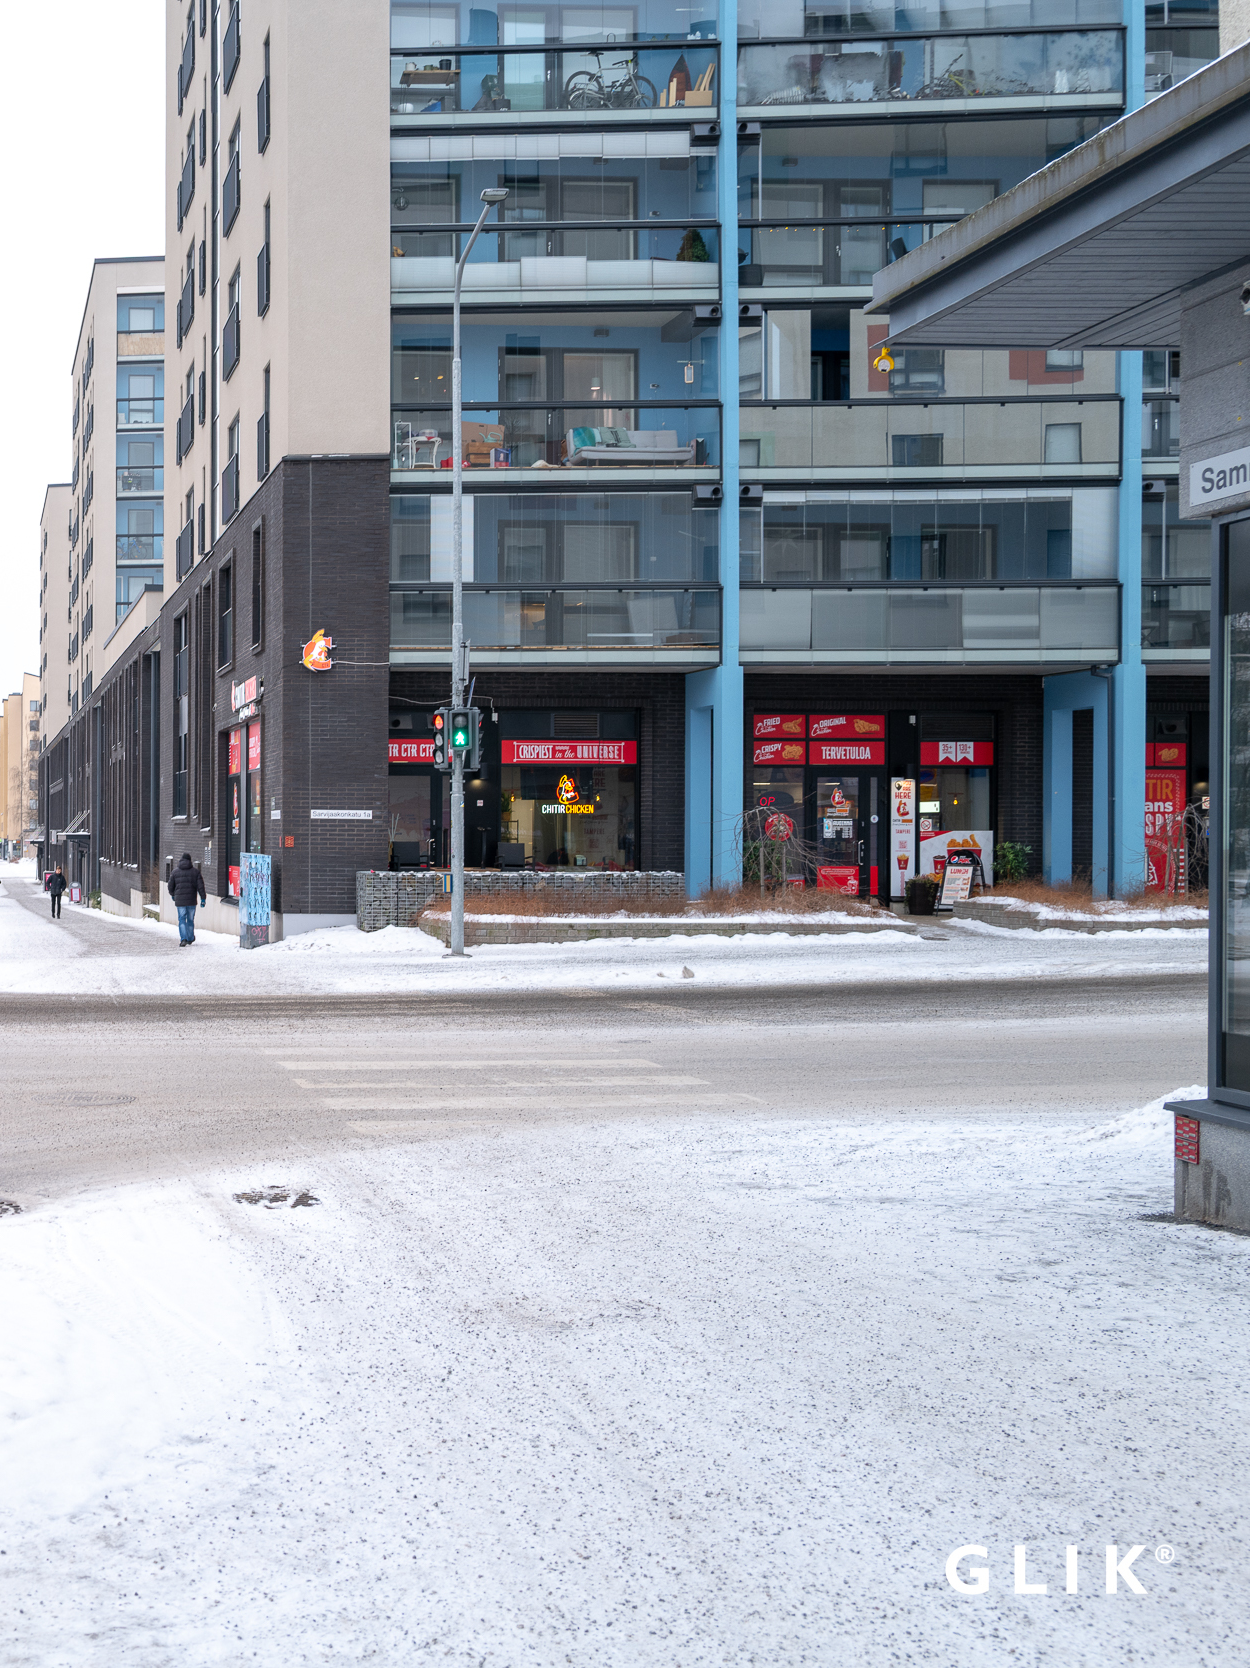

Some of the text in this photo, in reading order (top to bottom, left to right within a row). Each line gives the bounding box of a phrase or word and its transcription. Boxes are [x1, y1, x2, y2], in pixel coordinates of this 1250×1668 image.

[1201, 463, 1250, 494] Sam
[763, 717, 781, 727] FRIED
[819, 716, 846, 728] ORIGINAL
[388, 744, 399, 757] TR
[401, 744, 417, 757] CTR
[518, 745, 553, 759] CRISPIEST
[564, 749, 575, 758] the
[576, 746, 619, 759] UNIVERSE
[761, 743, 782, 753] CRISPY
[821, 747, 871, 759] TERVETULOA
[1146, 779, 1173, 799] TIR
[541, 804, 595, 814] CHITIR CHICKEN
[1145, 801, 1173, 812] ans
[1145, 813, 1173, 836] SPY
